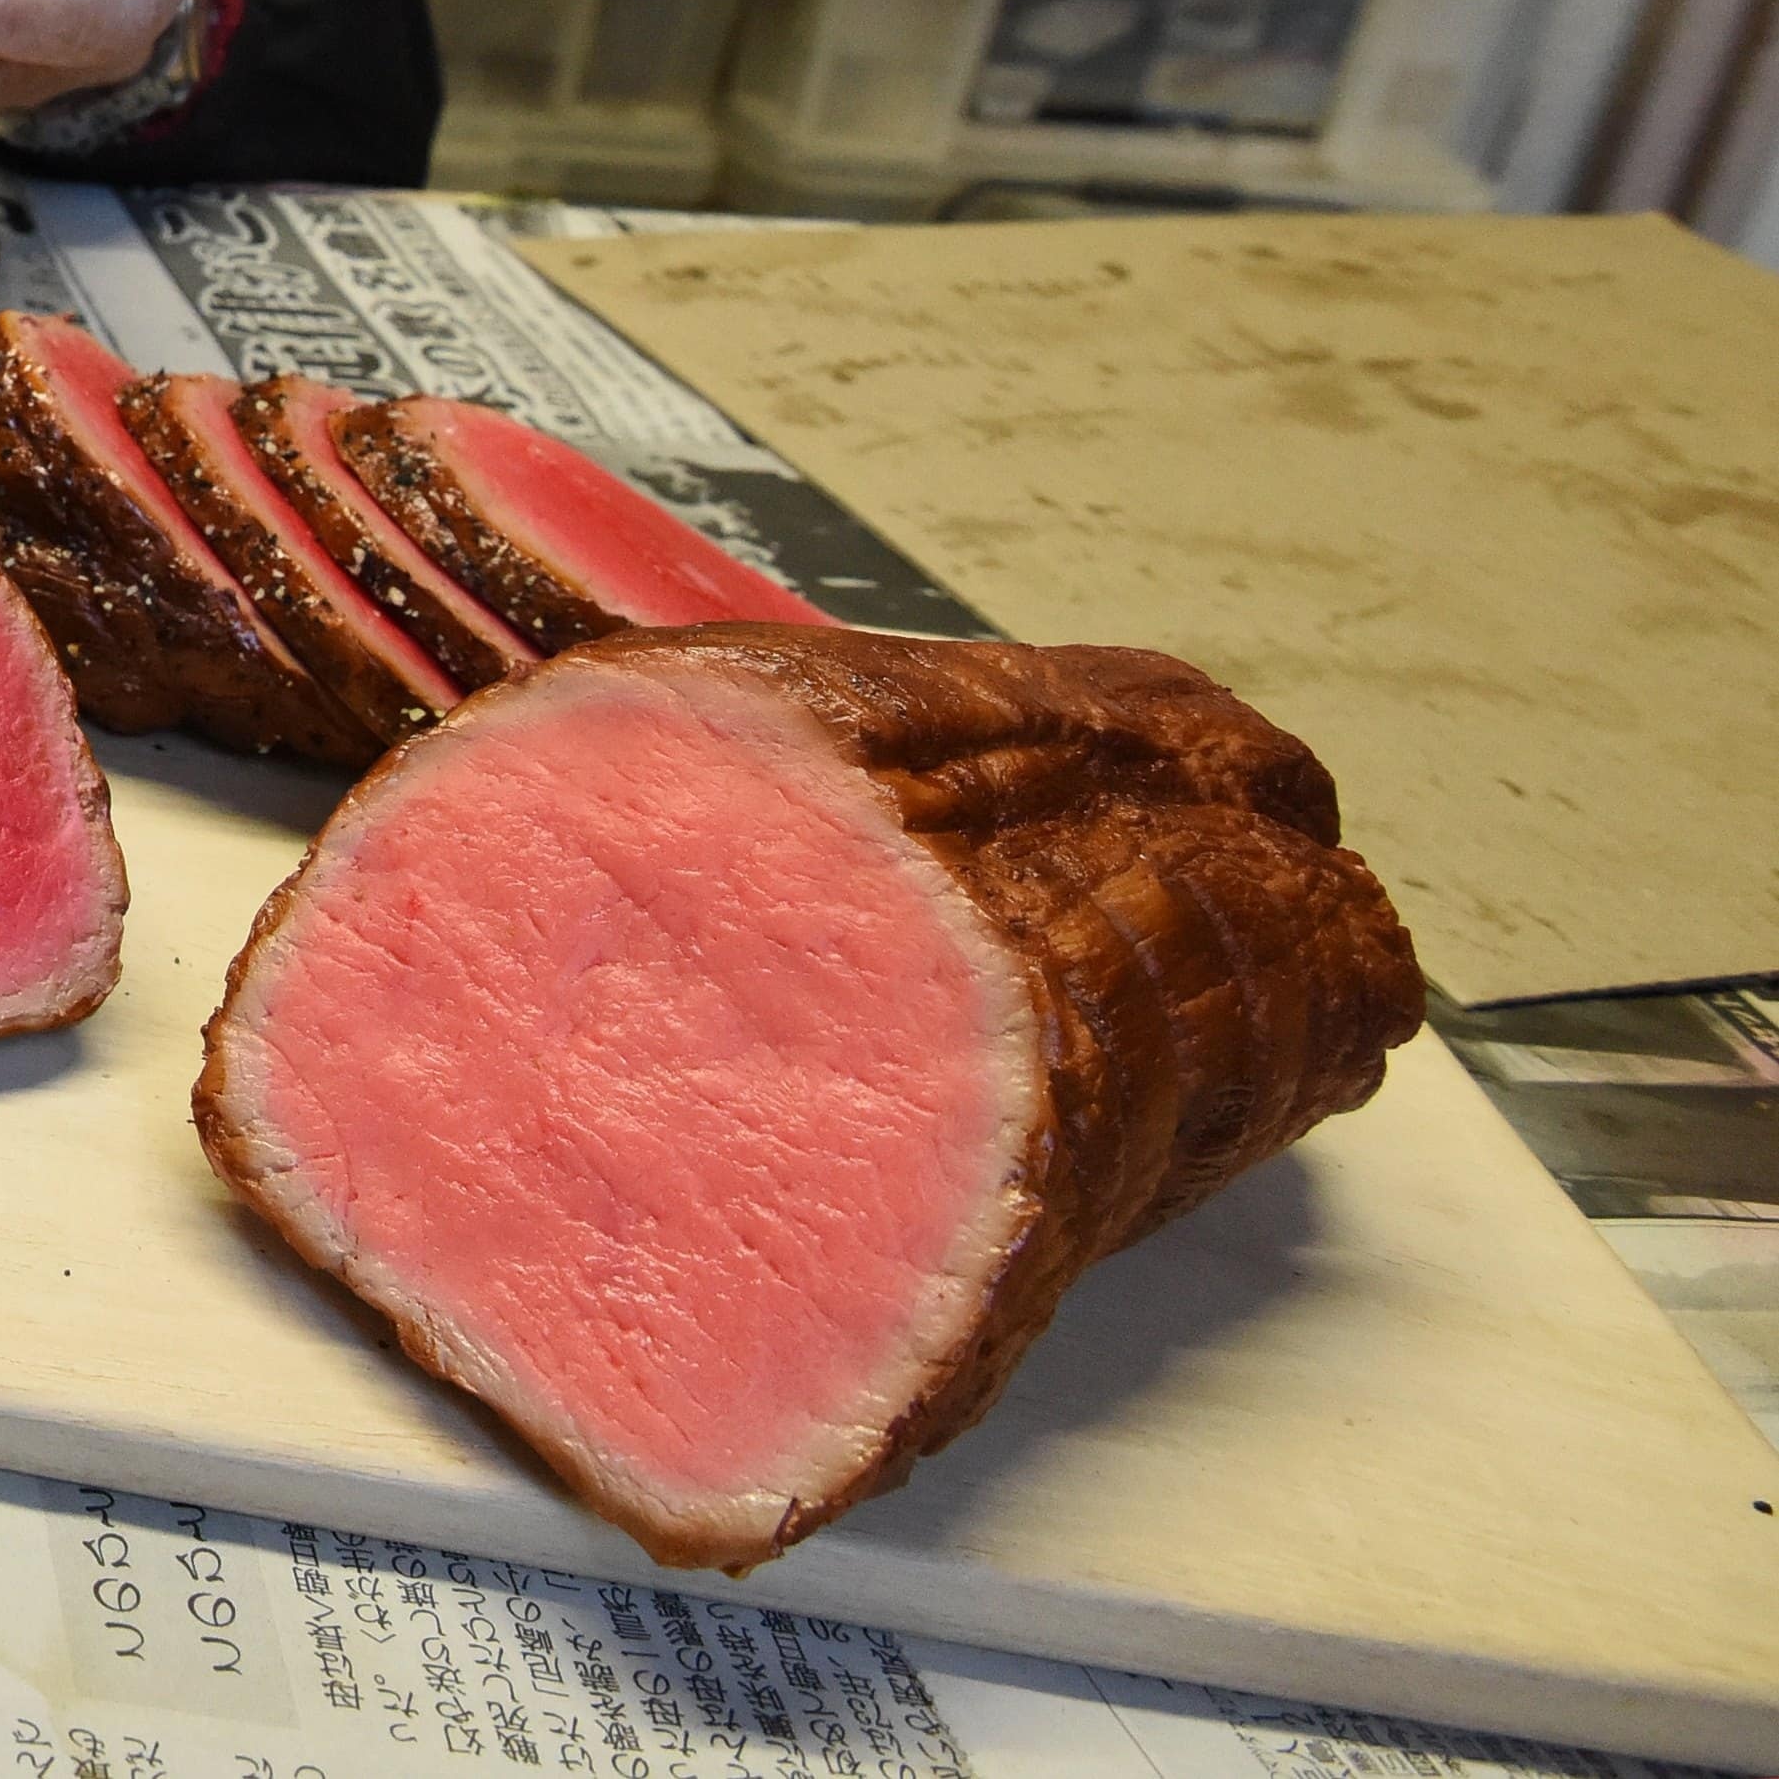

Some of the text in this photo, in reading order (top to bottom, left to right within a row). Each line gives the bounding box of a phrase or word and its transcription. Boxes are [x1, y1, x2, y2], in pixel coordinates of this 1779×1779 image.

[77, 1487, 147, 1663] このひと
[168, 1501, 244, 1676] このひと
[491, 1558, 594, 1777] けた「尼崎の小
